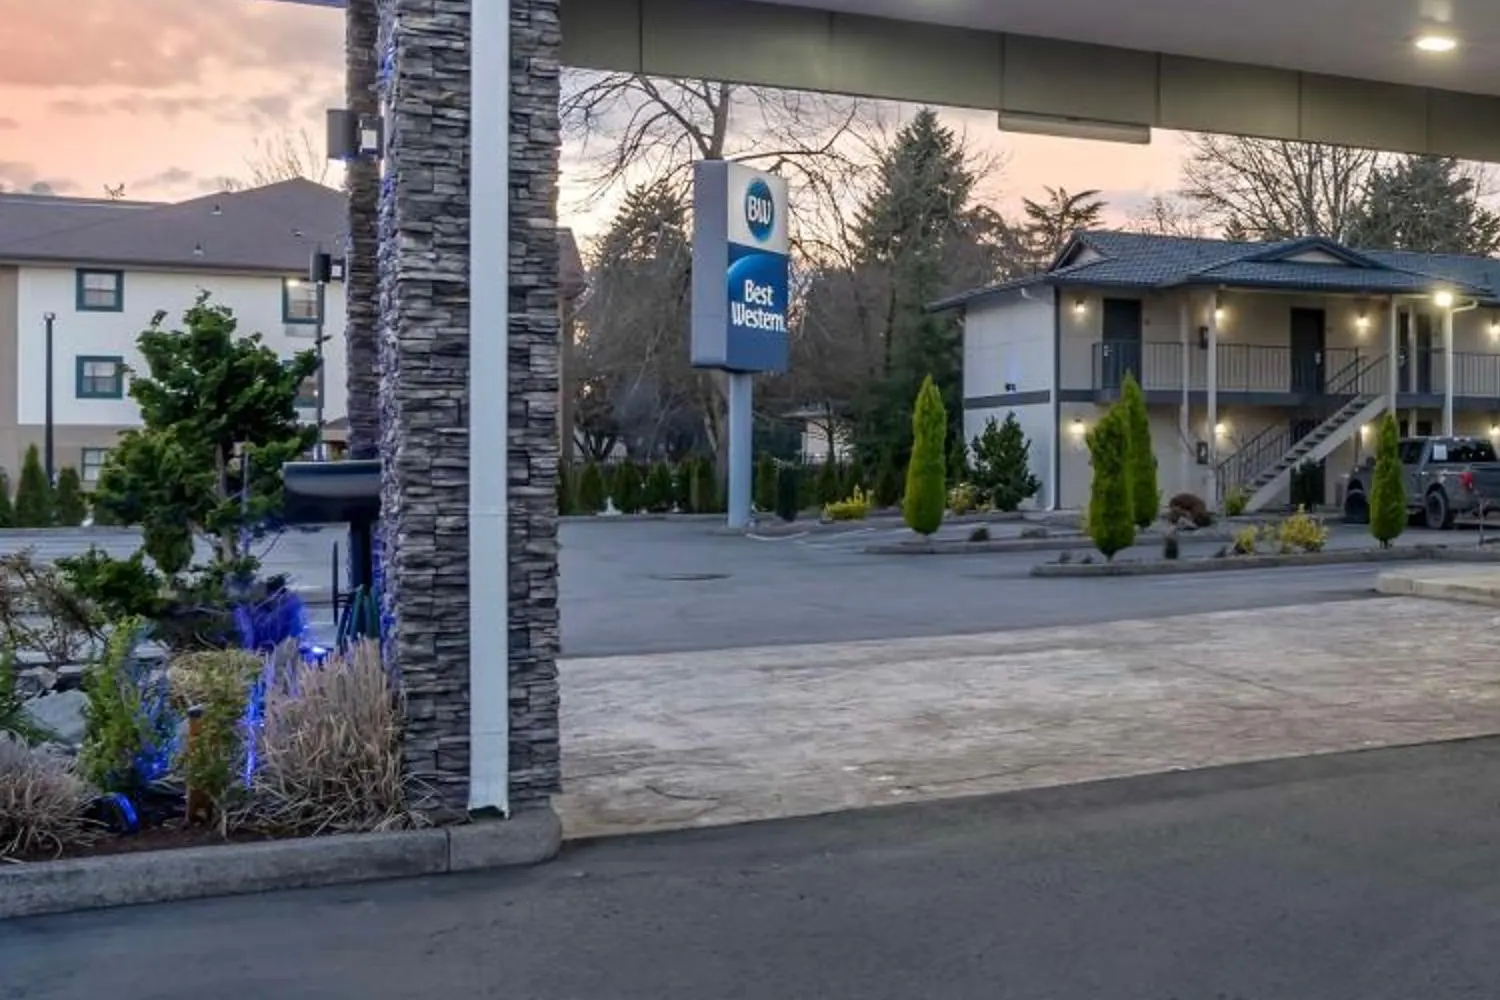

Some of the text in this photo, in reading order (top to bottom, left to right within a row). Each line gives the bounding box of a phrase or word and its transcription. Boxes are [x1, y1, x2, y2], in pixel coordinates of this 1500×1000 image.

[747, 195, 772, 226] BW
[744, 279, 774, 306] Best
[731, 302, 784, 332] Western
